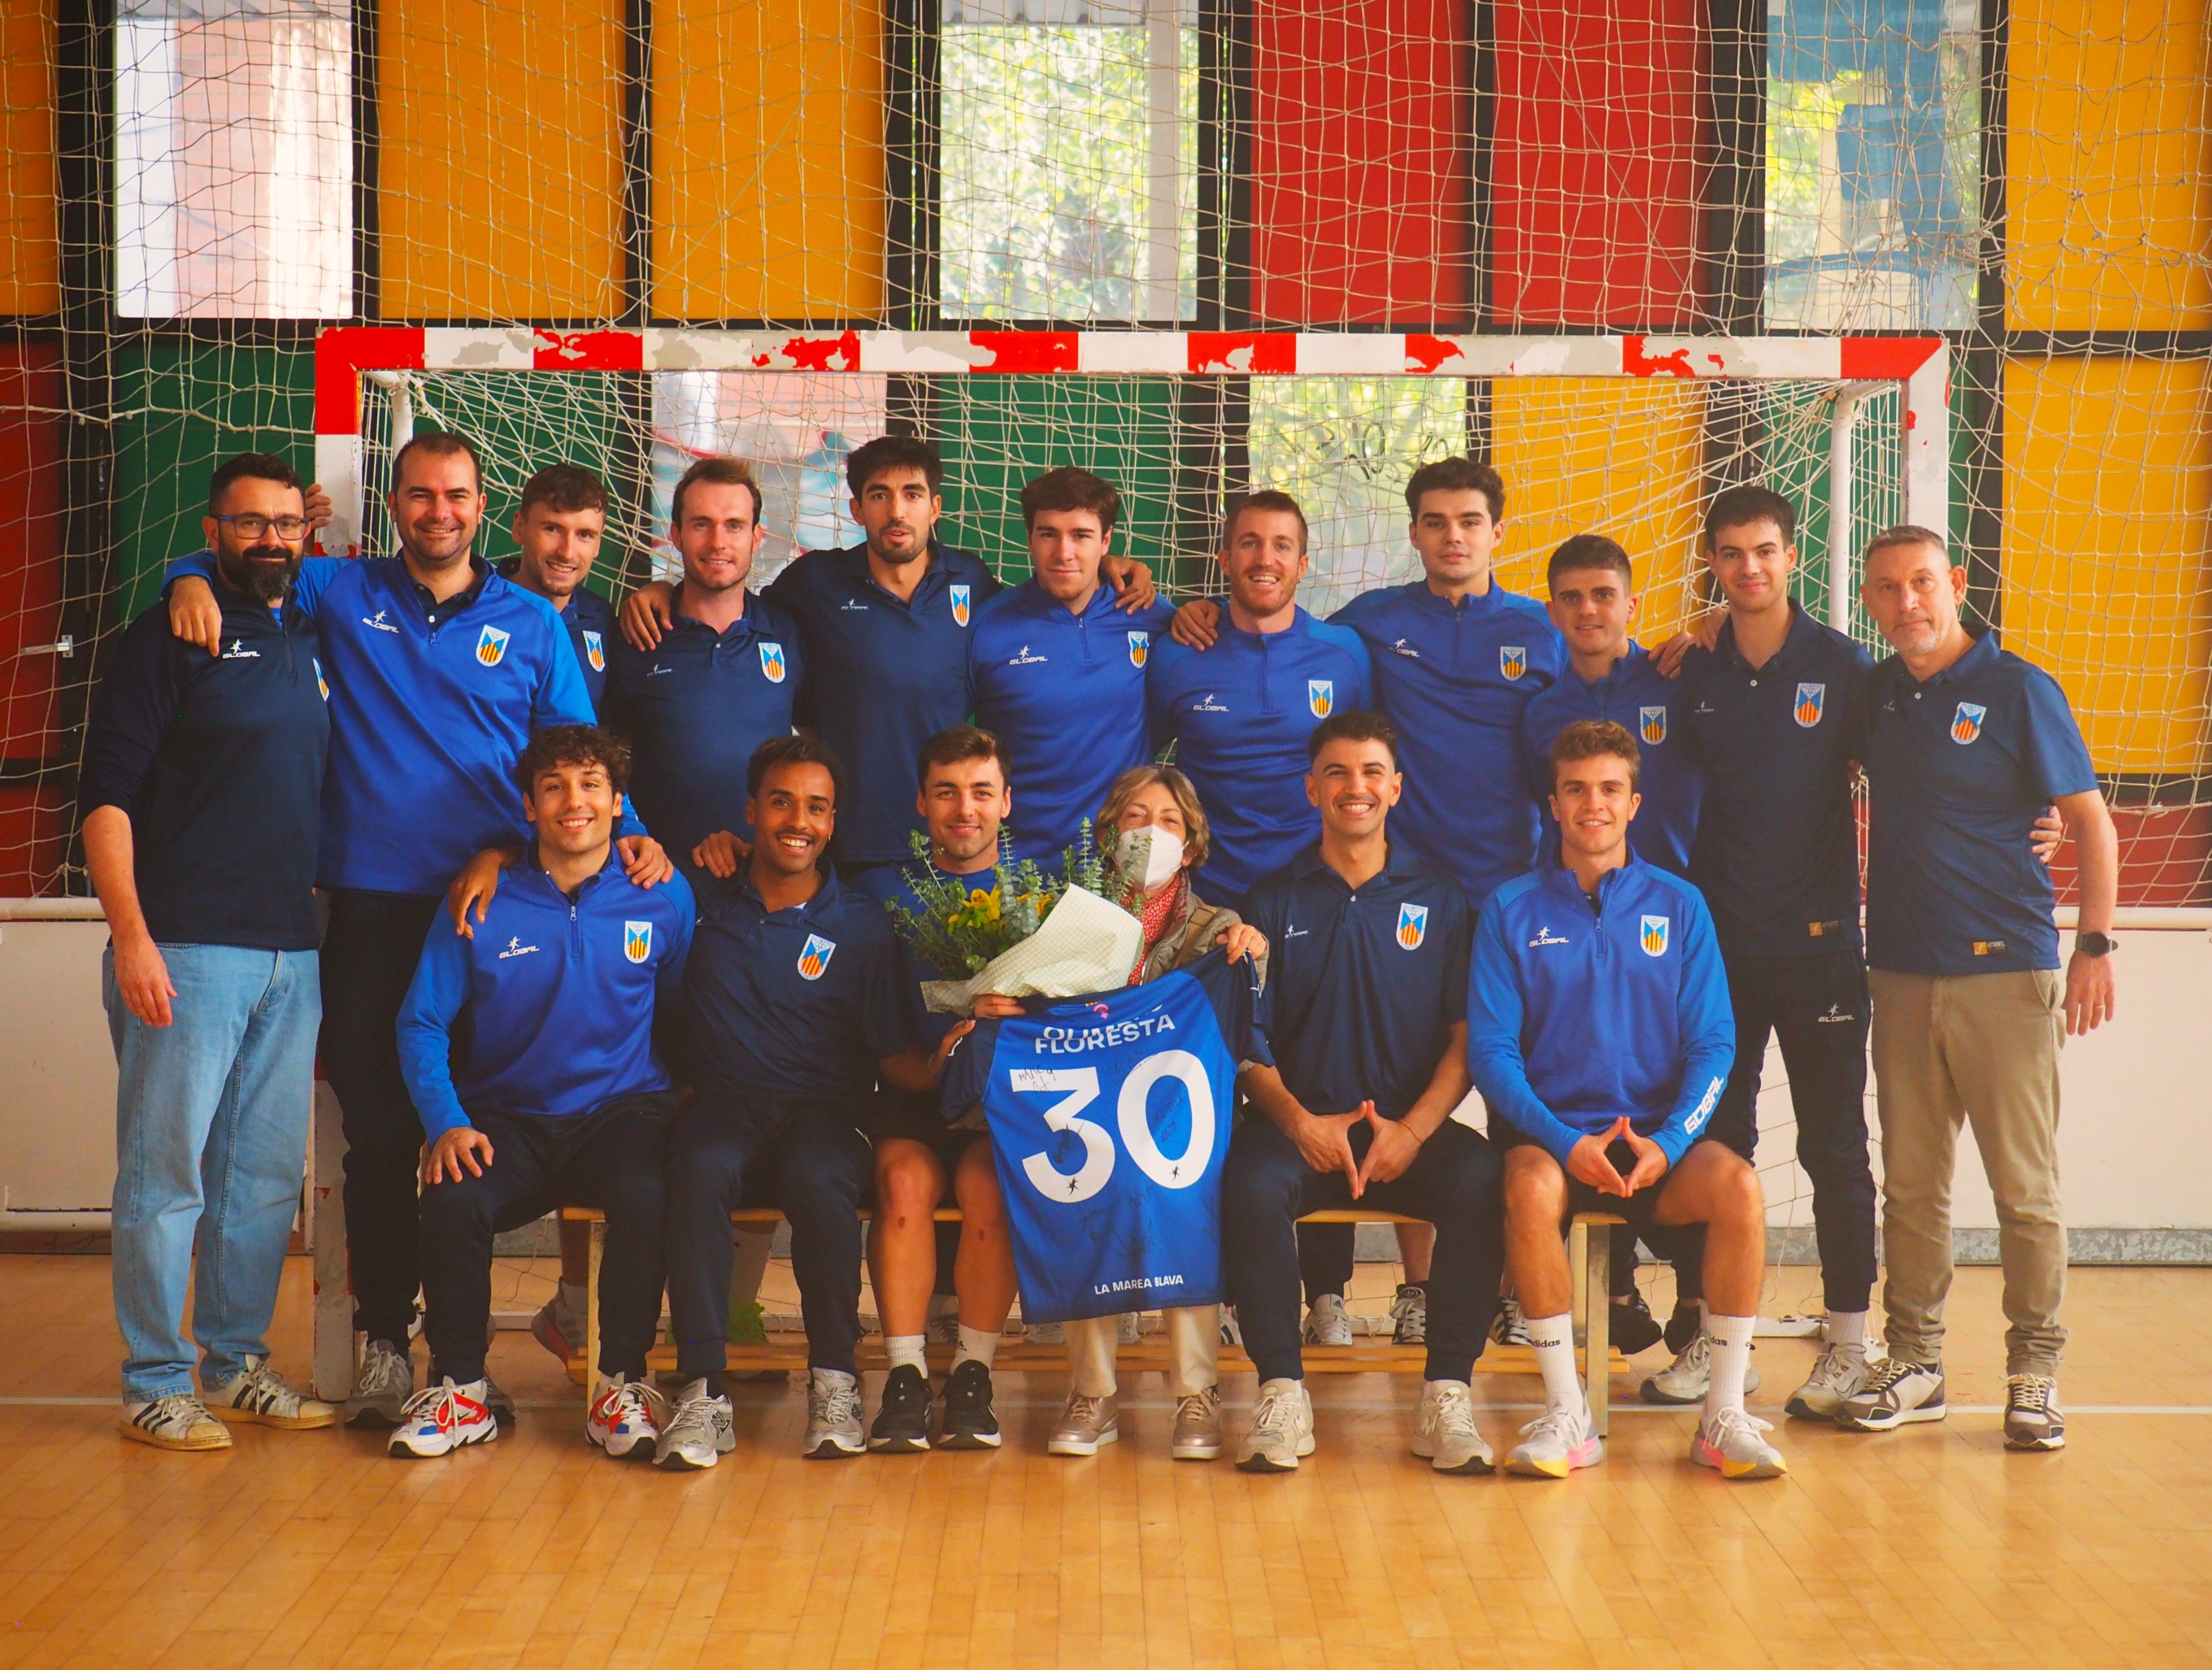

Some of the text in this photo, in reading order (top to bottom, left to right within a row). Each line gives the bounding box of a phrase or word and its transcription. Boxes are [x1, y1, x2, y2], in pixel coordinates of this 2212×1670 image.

[362, 617, 400, 633] GLOBAL
[222, 651, 260, 659] GLOBAL
[1009, 656, 1048, 665] GLOBAL
[1528, 936, 1569, 947] GLOBAL
[499, 945, 540, 959] GLOBAL
[1818, 1014, 1855, 1022] GLOBAL
[1035, 1014, 1176, 1054] FLORESTA
[1010, 1049, 1215, 1203] 30
[1094, 1274, 1184, 1295] LA MAREA BLAVA
